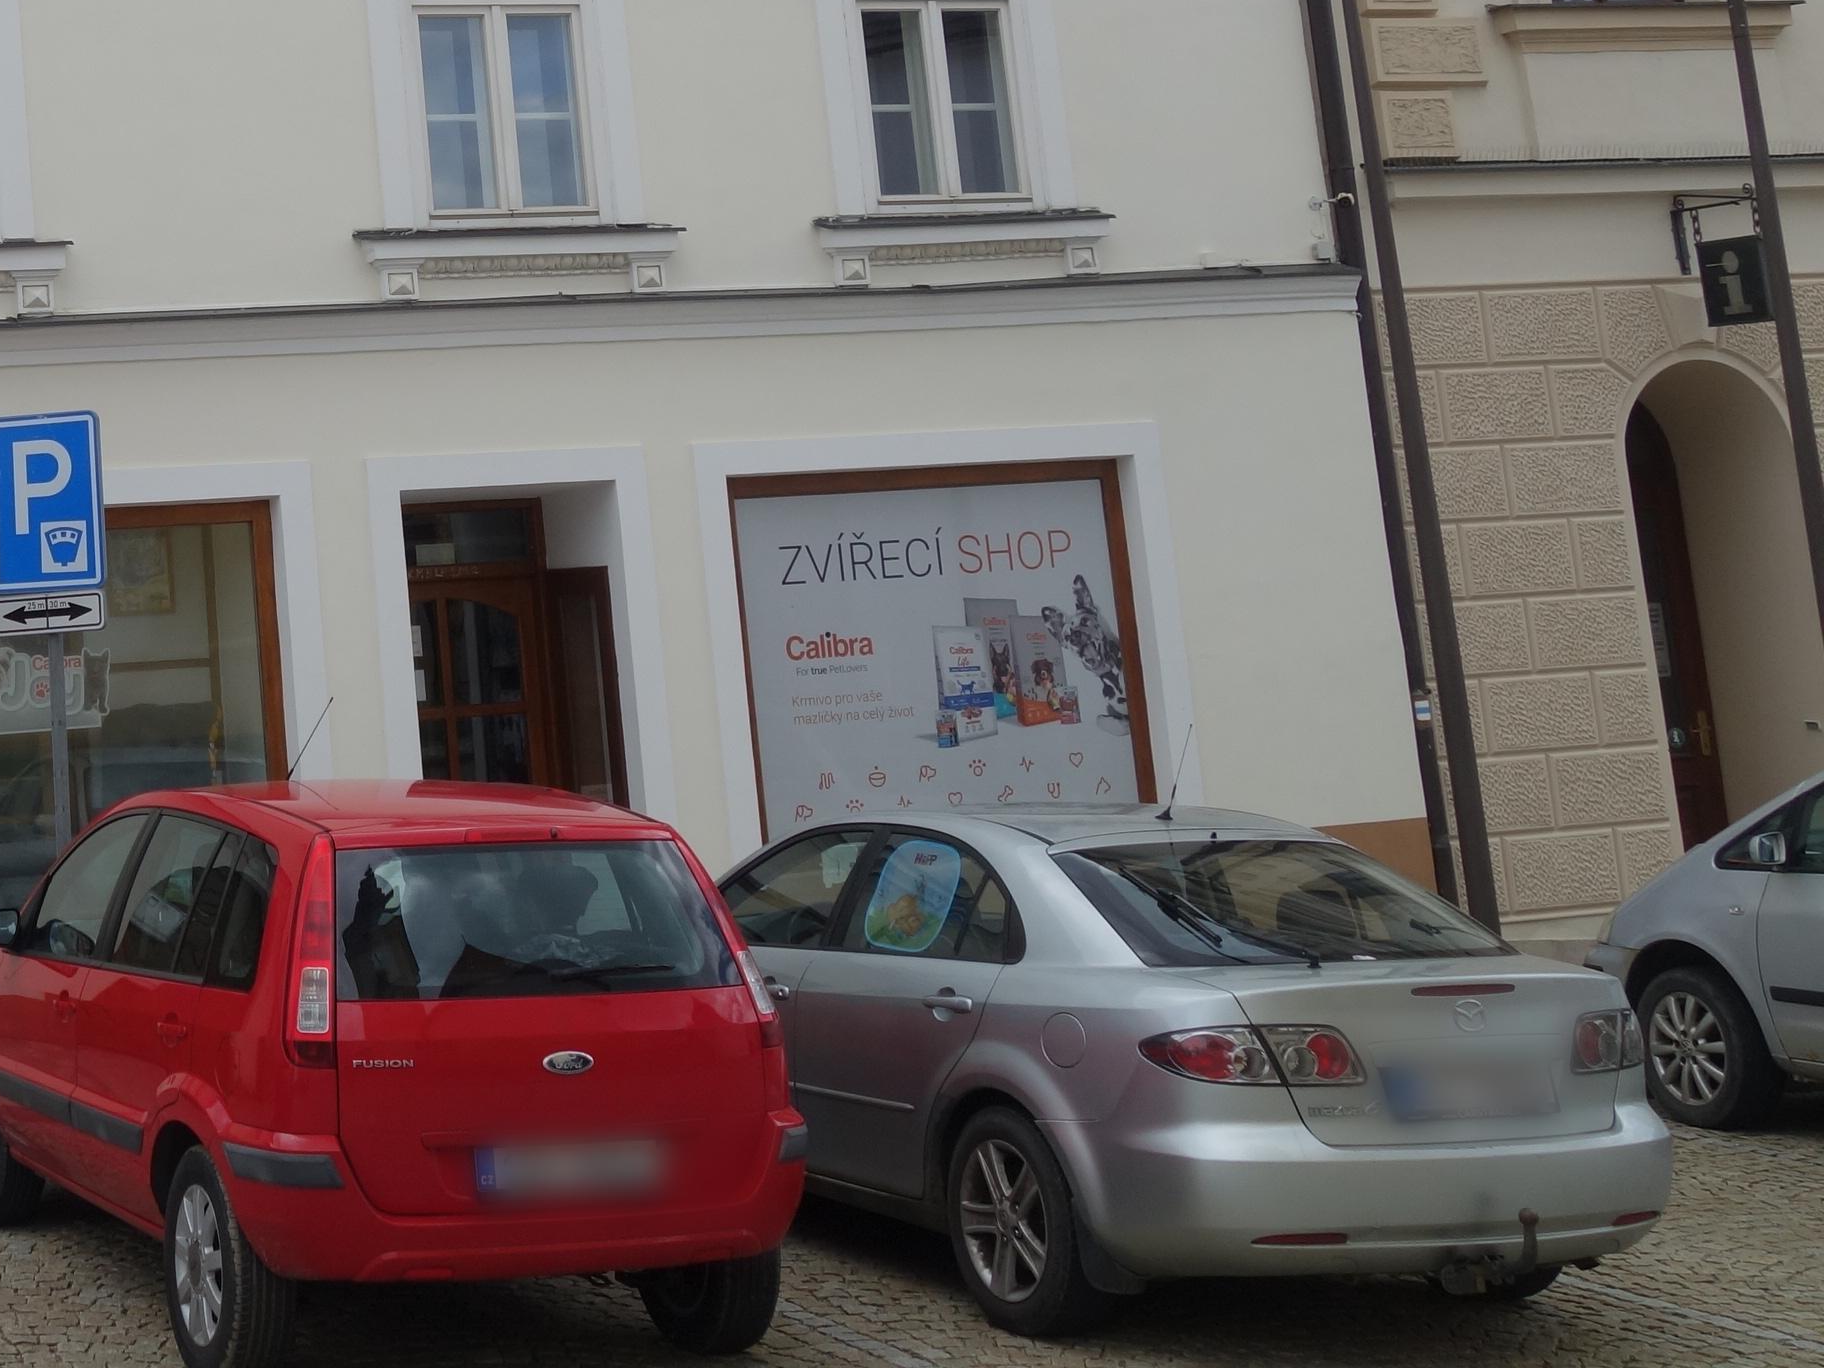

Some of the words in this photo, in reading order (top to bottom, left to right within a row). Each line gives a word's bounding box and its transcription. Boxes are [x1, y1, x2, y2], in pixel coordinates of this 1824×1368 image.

[12, 439, 72, 535] P
[778, 526, 944, 586] ZVÍŘECÍ
[957, 529, 1072, 574] SHOP
[27, 601, 36, 609] 25
[48, 600, 58, 608] 30
[785, 631, 875, 661] Calibra
[32, 657, 81, 671] Cara
[795, 666, 809, 677] For
[810, 665, 828, 675] true
[791, 694, 833, 707] Krmivo
[835, 693, 854, 707] pro
[856, 689, 883, 703] vaše
[845, 709, 860, 721] na
[887, 705, 915, 719] život
[352, 1058, 415, 1069] FUSION
